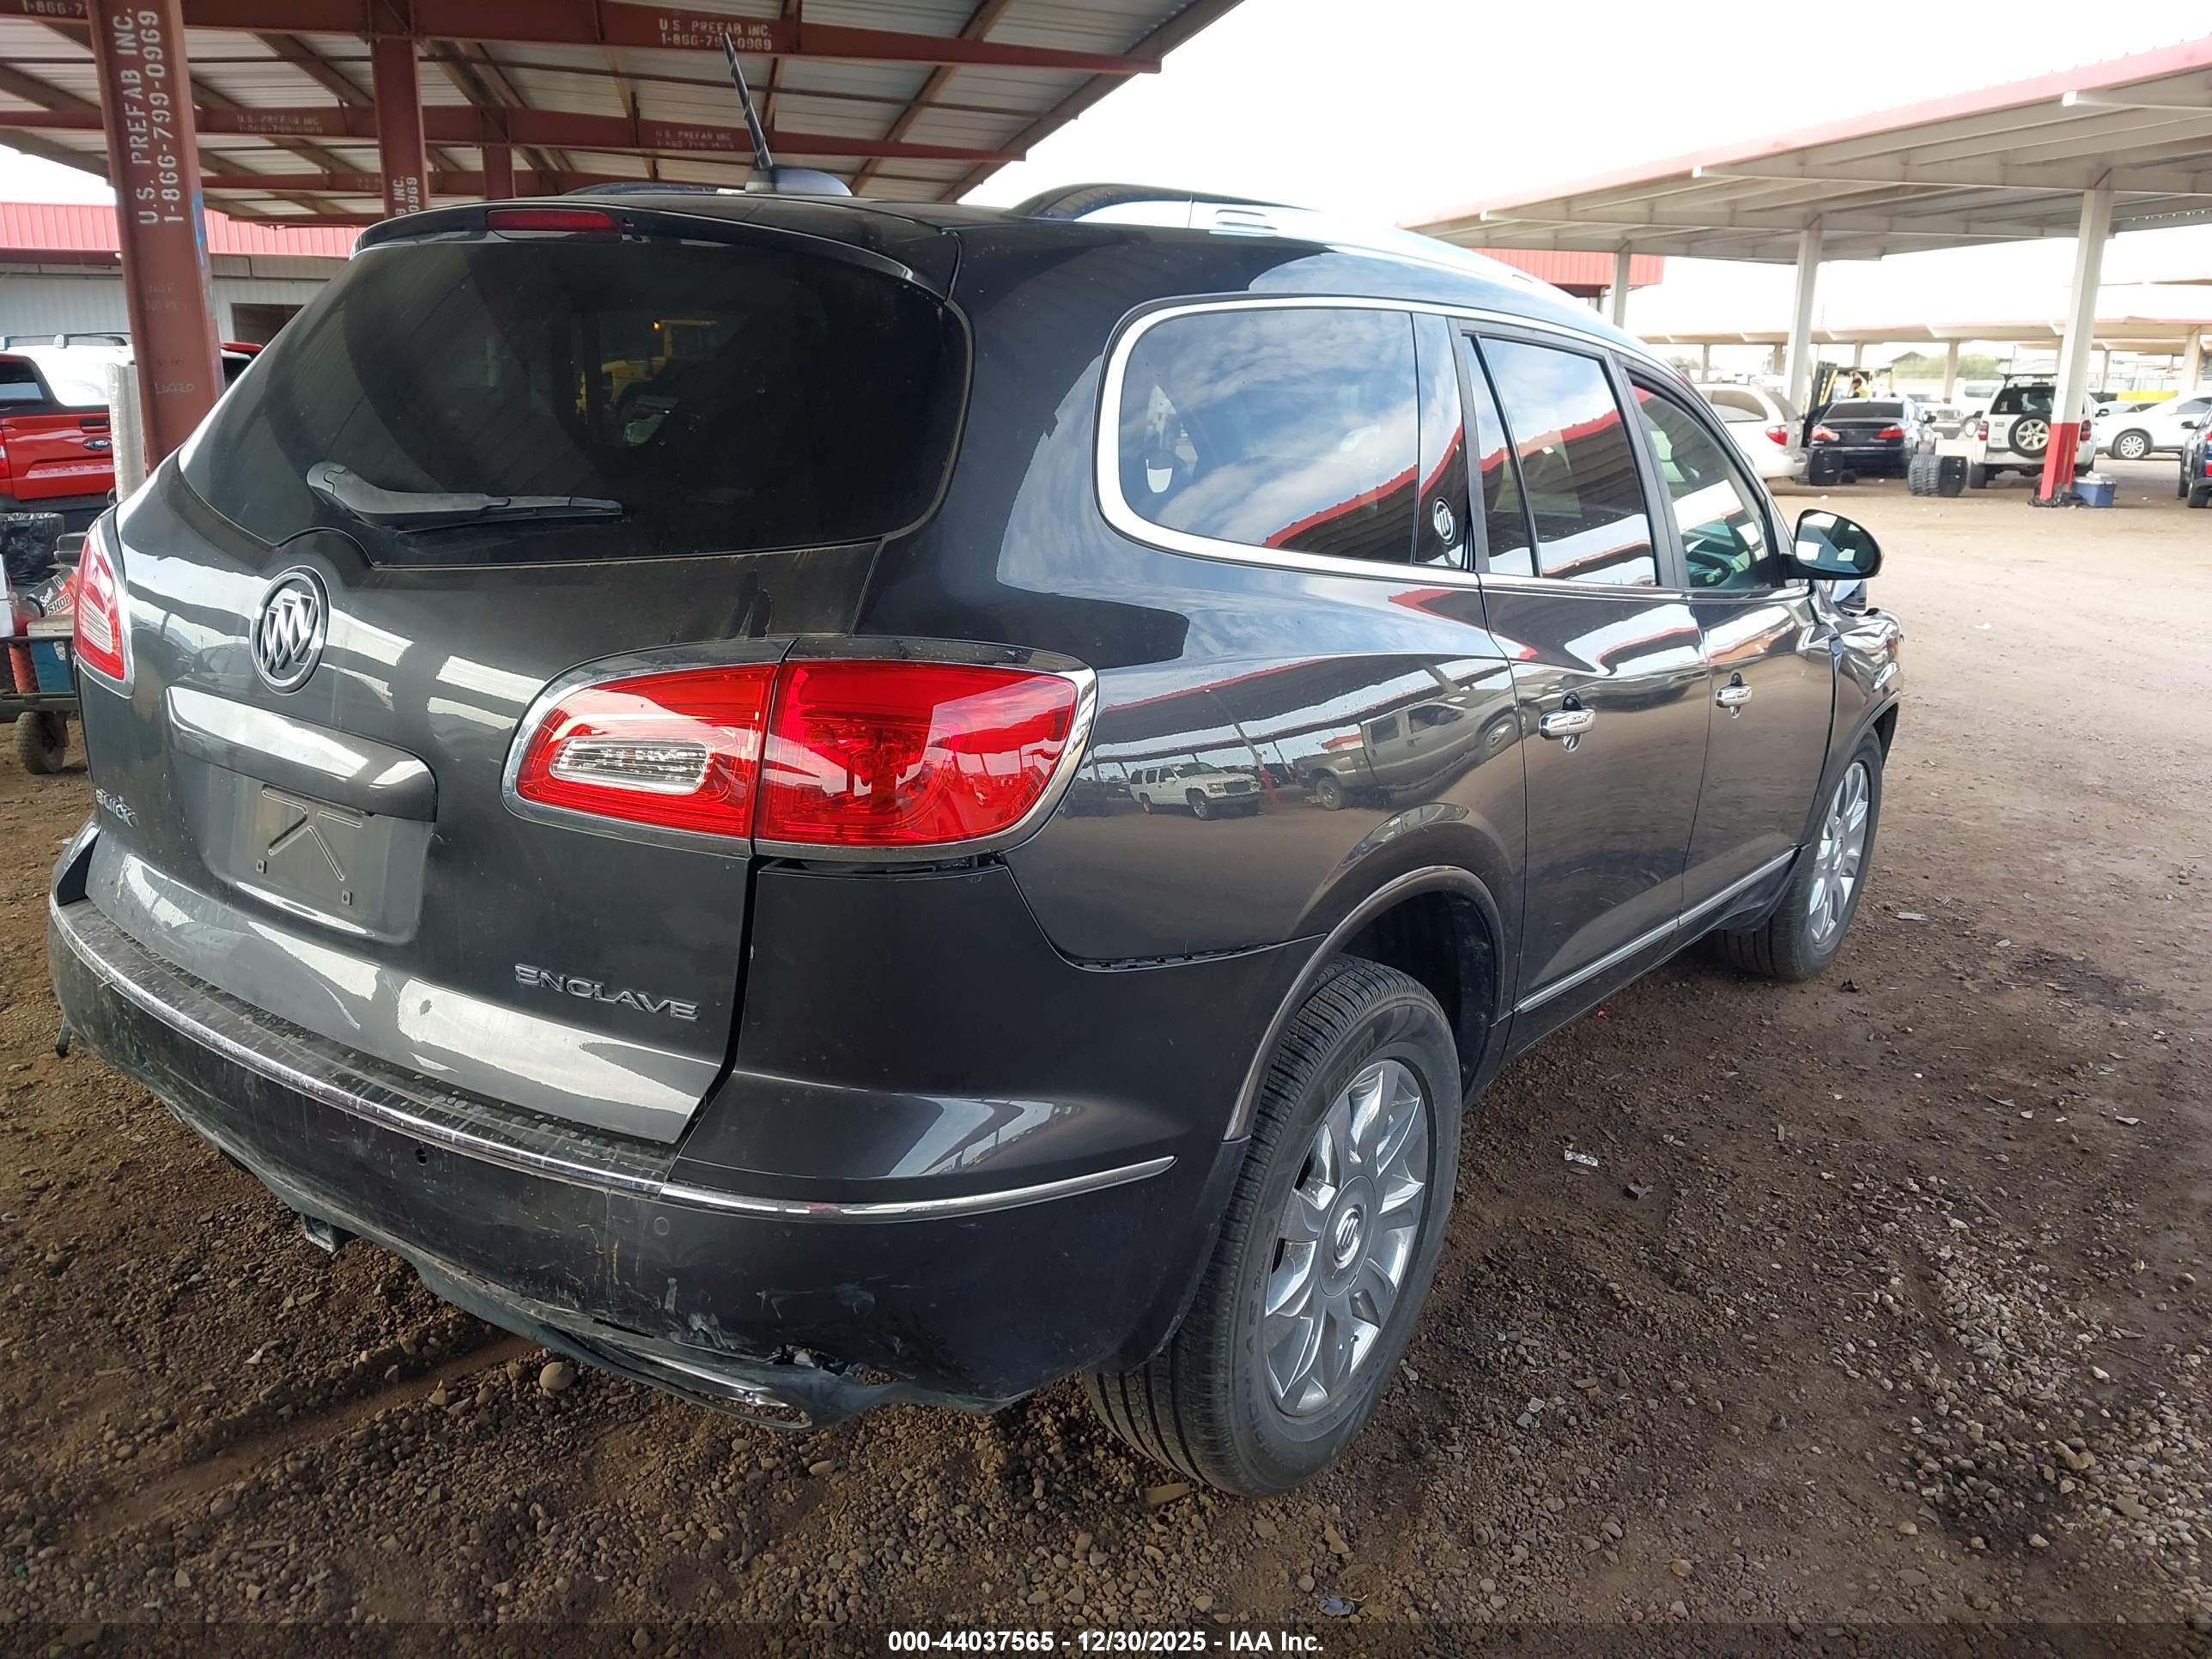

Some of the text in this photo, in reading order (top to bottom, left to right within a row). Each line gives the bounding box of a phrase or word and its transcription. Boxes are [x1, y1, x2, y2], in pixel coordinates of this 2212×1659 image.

[22, 0, 87, 15] 1-866-7
[691, 21, 742, 35] PREFAB
[661, 33, 772, 51] 1-866-79-0969
[112, 8, 159, 225] U.S. PREFAB INC.
[137, 10, 184, 222] 1-866-799-0969
[392, 176, 405, 201] INC.
[47, 592, 70, 616] SHOP
[514, 963, 700, 1024] ENCLAVE
